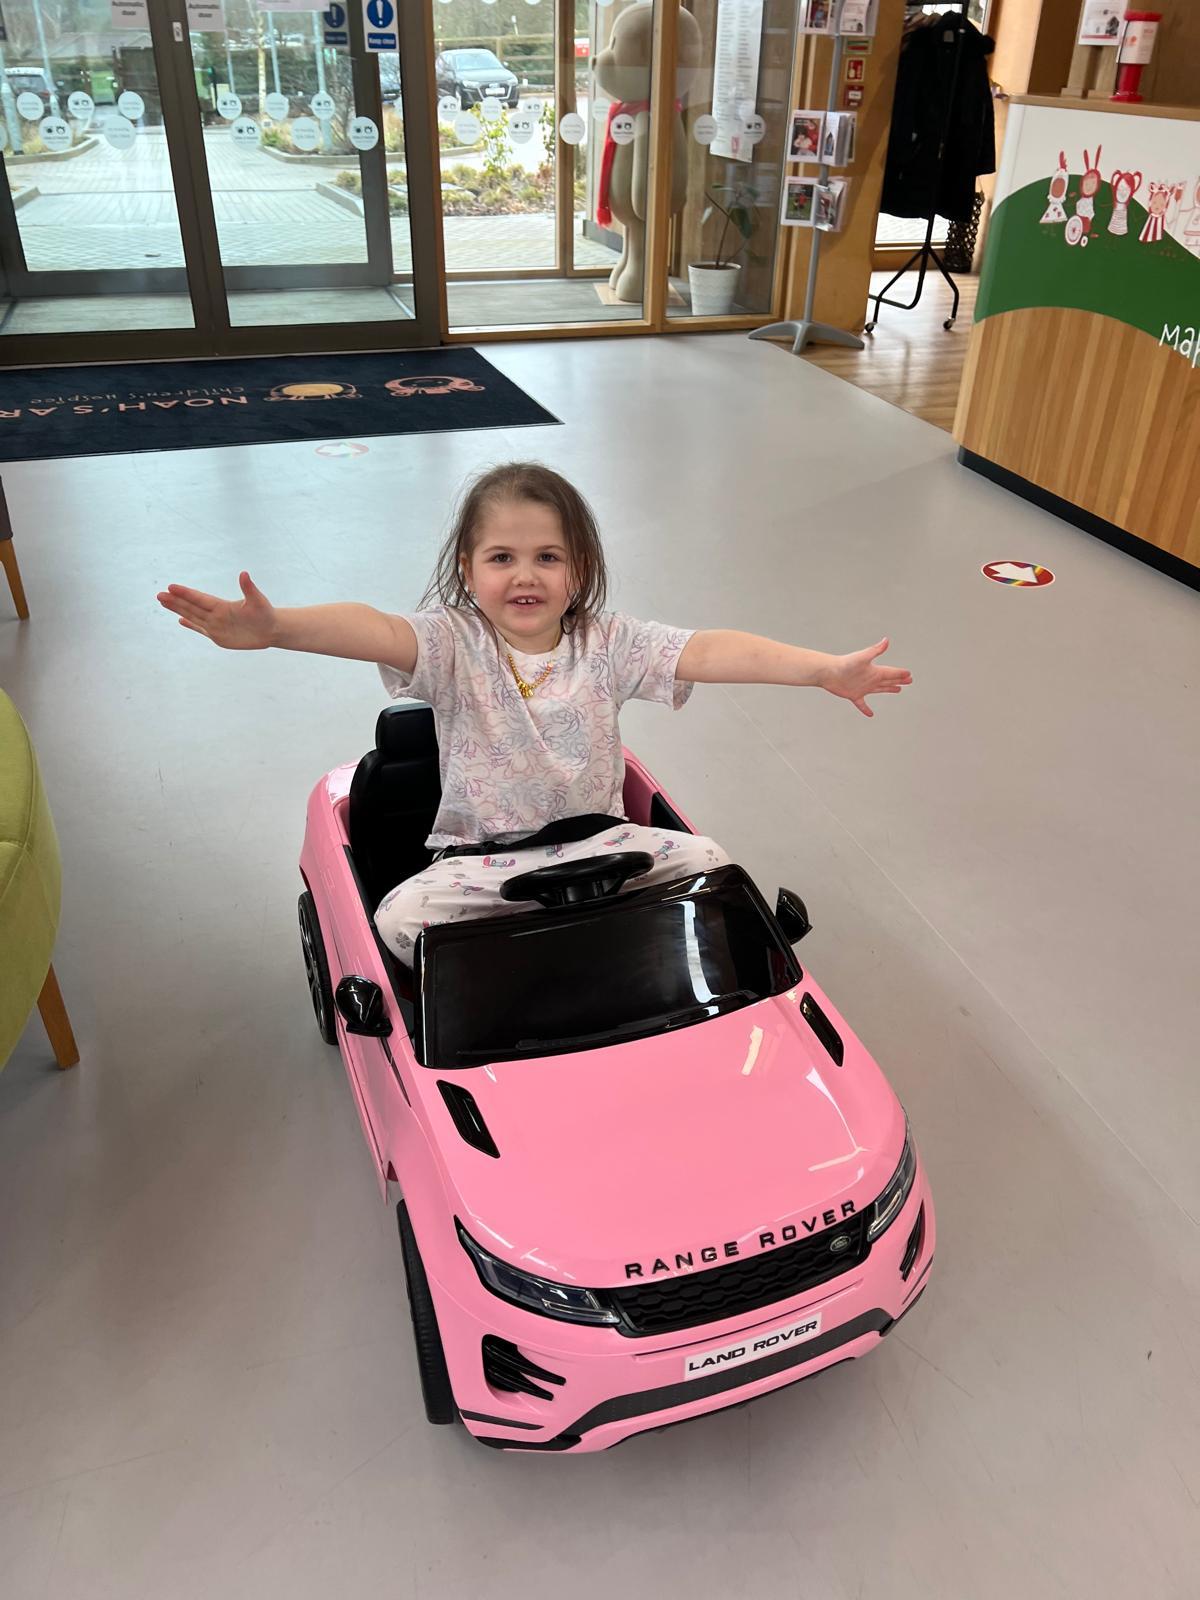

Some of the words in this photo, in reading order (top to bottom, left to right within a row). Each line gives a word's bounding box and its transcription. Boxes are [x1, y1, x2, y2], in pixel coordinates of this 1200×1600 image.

[73, 396, 248, 415] NOAH'S
[624, 1241, 740, 1279] RANGE
[759, 1200, 856, 1248] ROVER
[688, 1347, 746, 1371] LAND
[753, 1320, 818, 1351] ROVER
